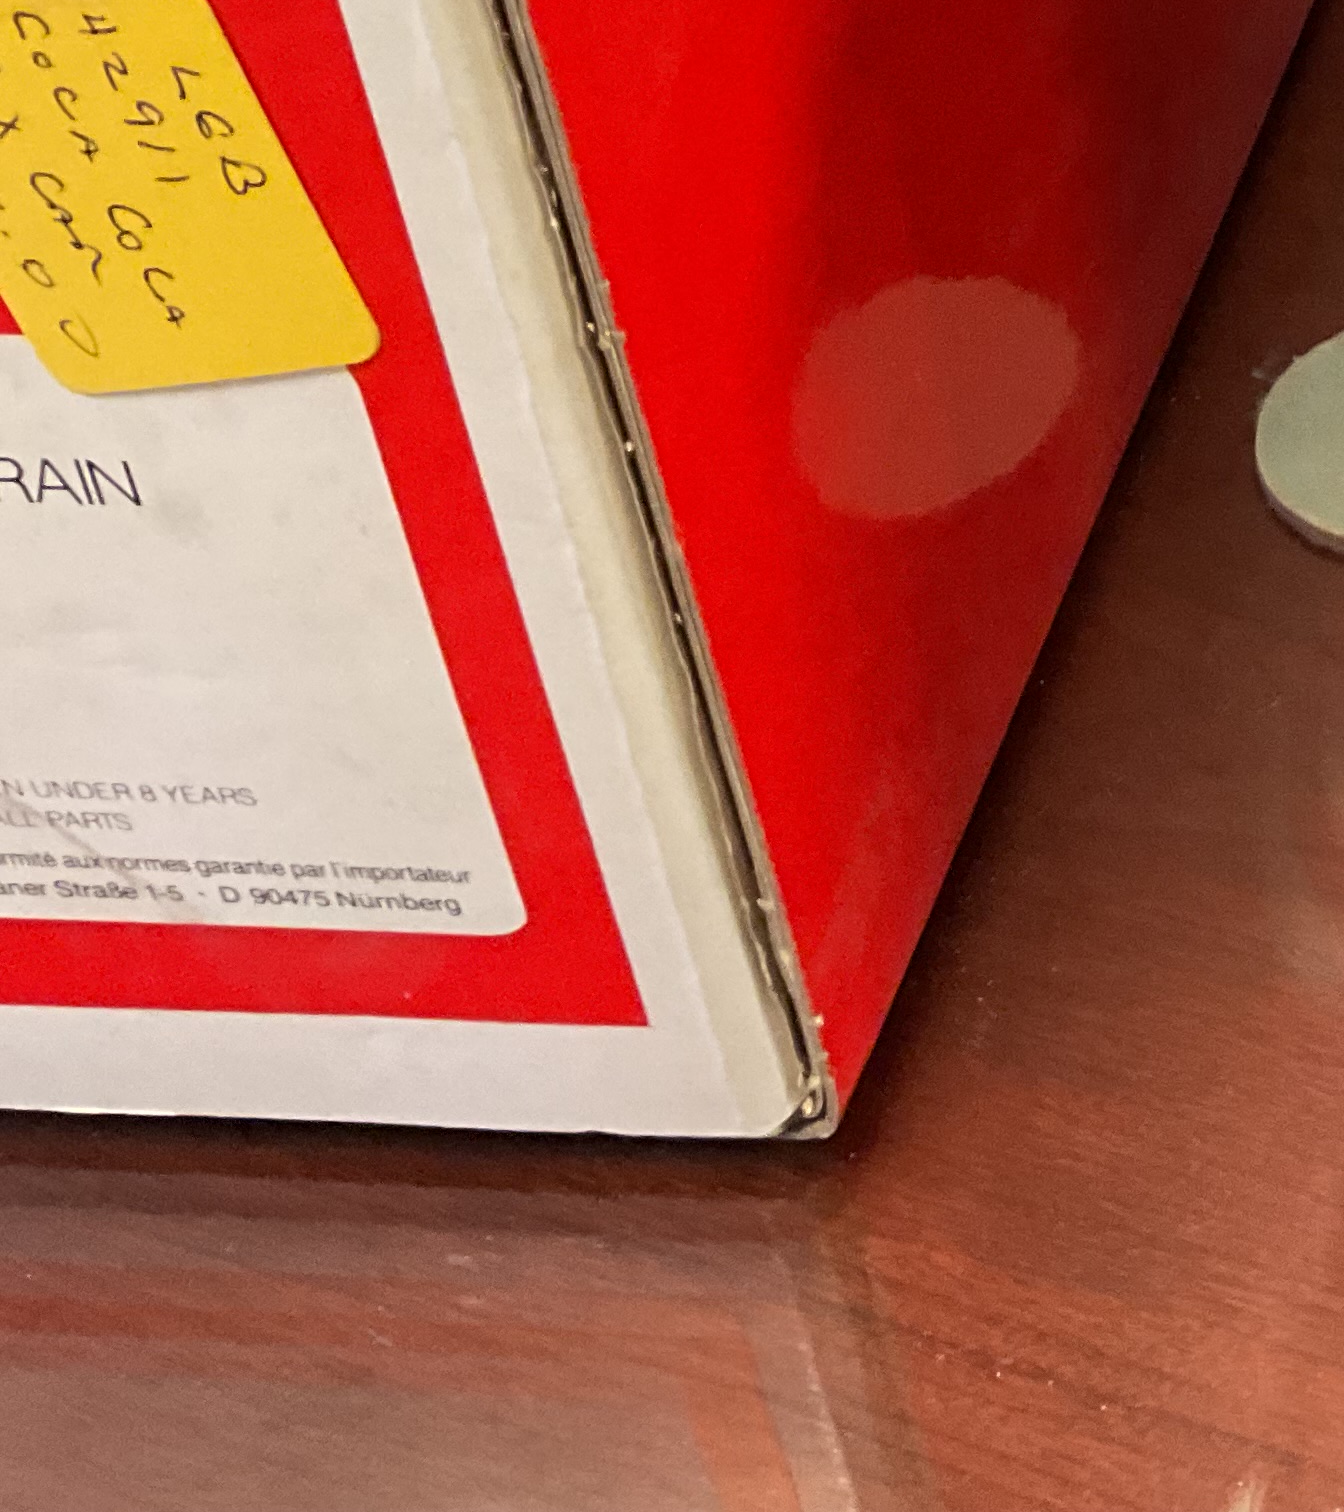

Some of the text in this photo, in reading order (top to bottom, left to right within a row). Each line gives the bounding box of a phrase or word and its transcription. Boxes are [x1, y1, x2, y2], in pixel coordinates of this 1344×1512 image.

[78, 13, 191, 183] 42911
[29, 779, 133, 801] UNDER
[161, 786, 258, 807] YEARS
[45, 810, 133, 831] PARTS
[289, 862, 325, 880] par
[219, 886, 241, 903] D
[250, 888, 331, 908] 90475
[334, 890, 464, 917] Nürnberg
